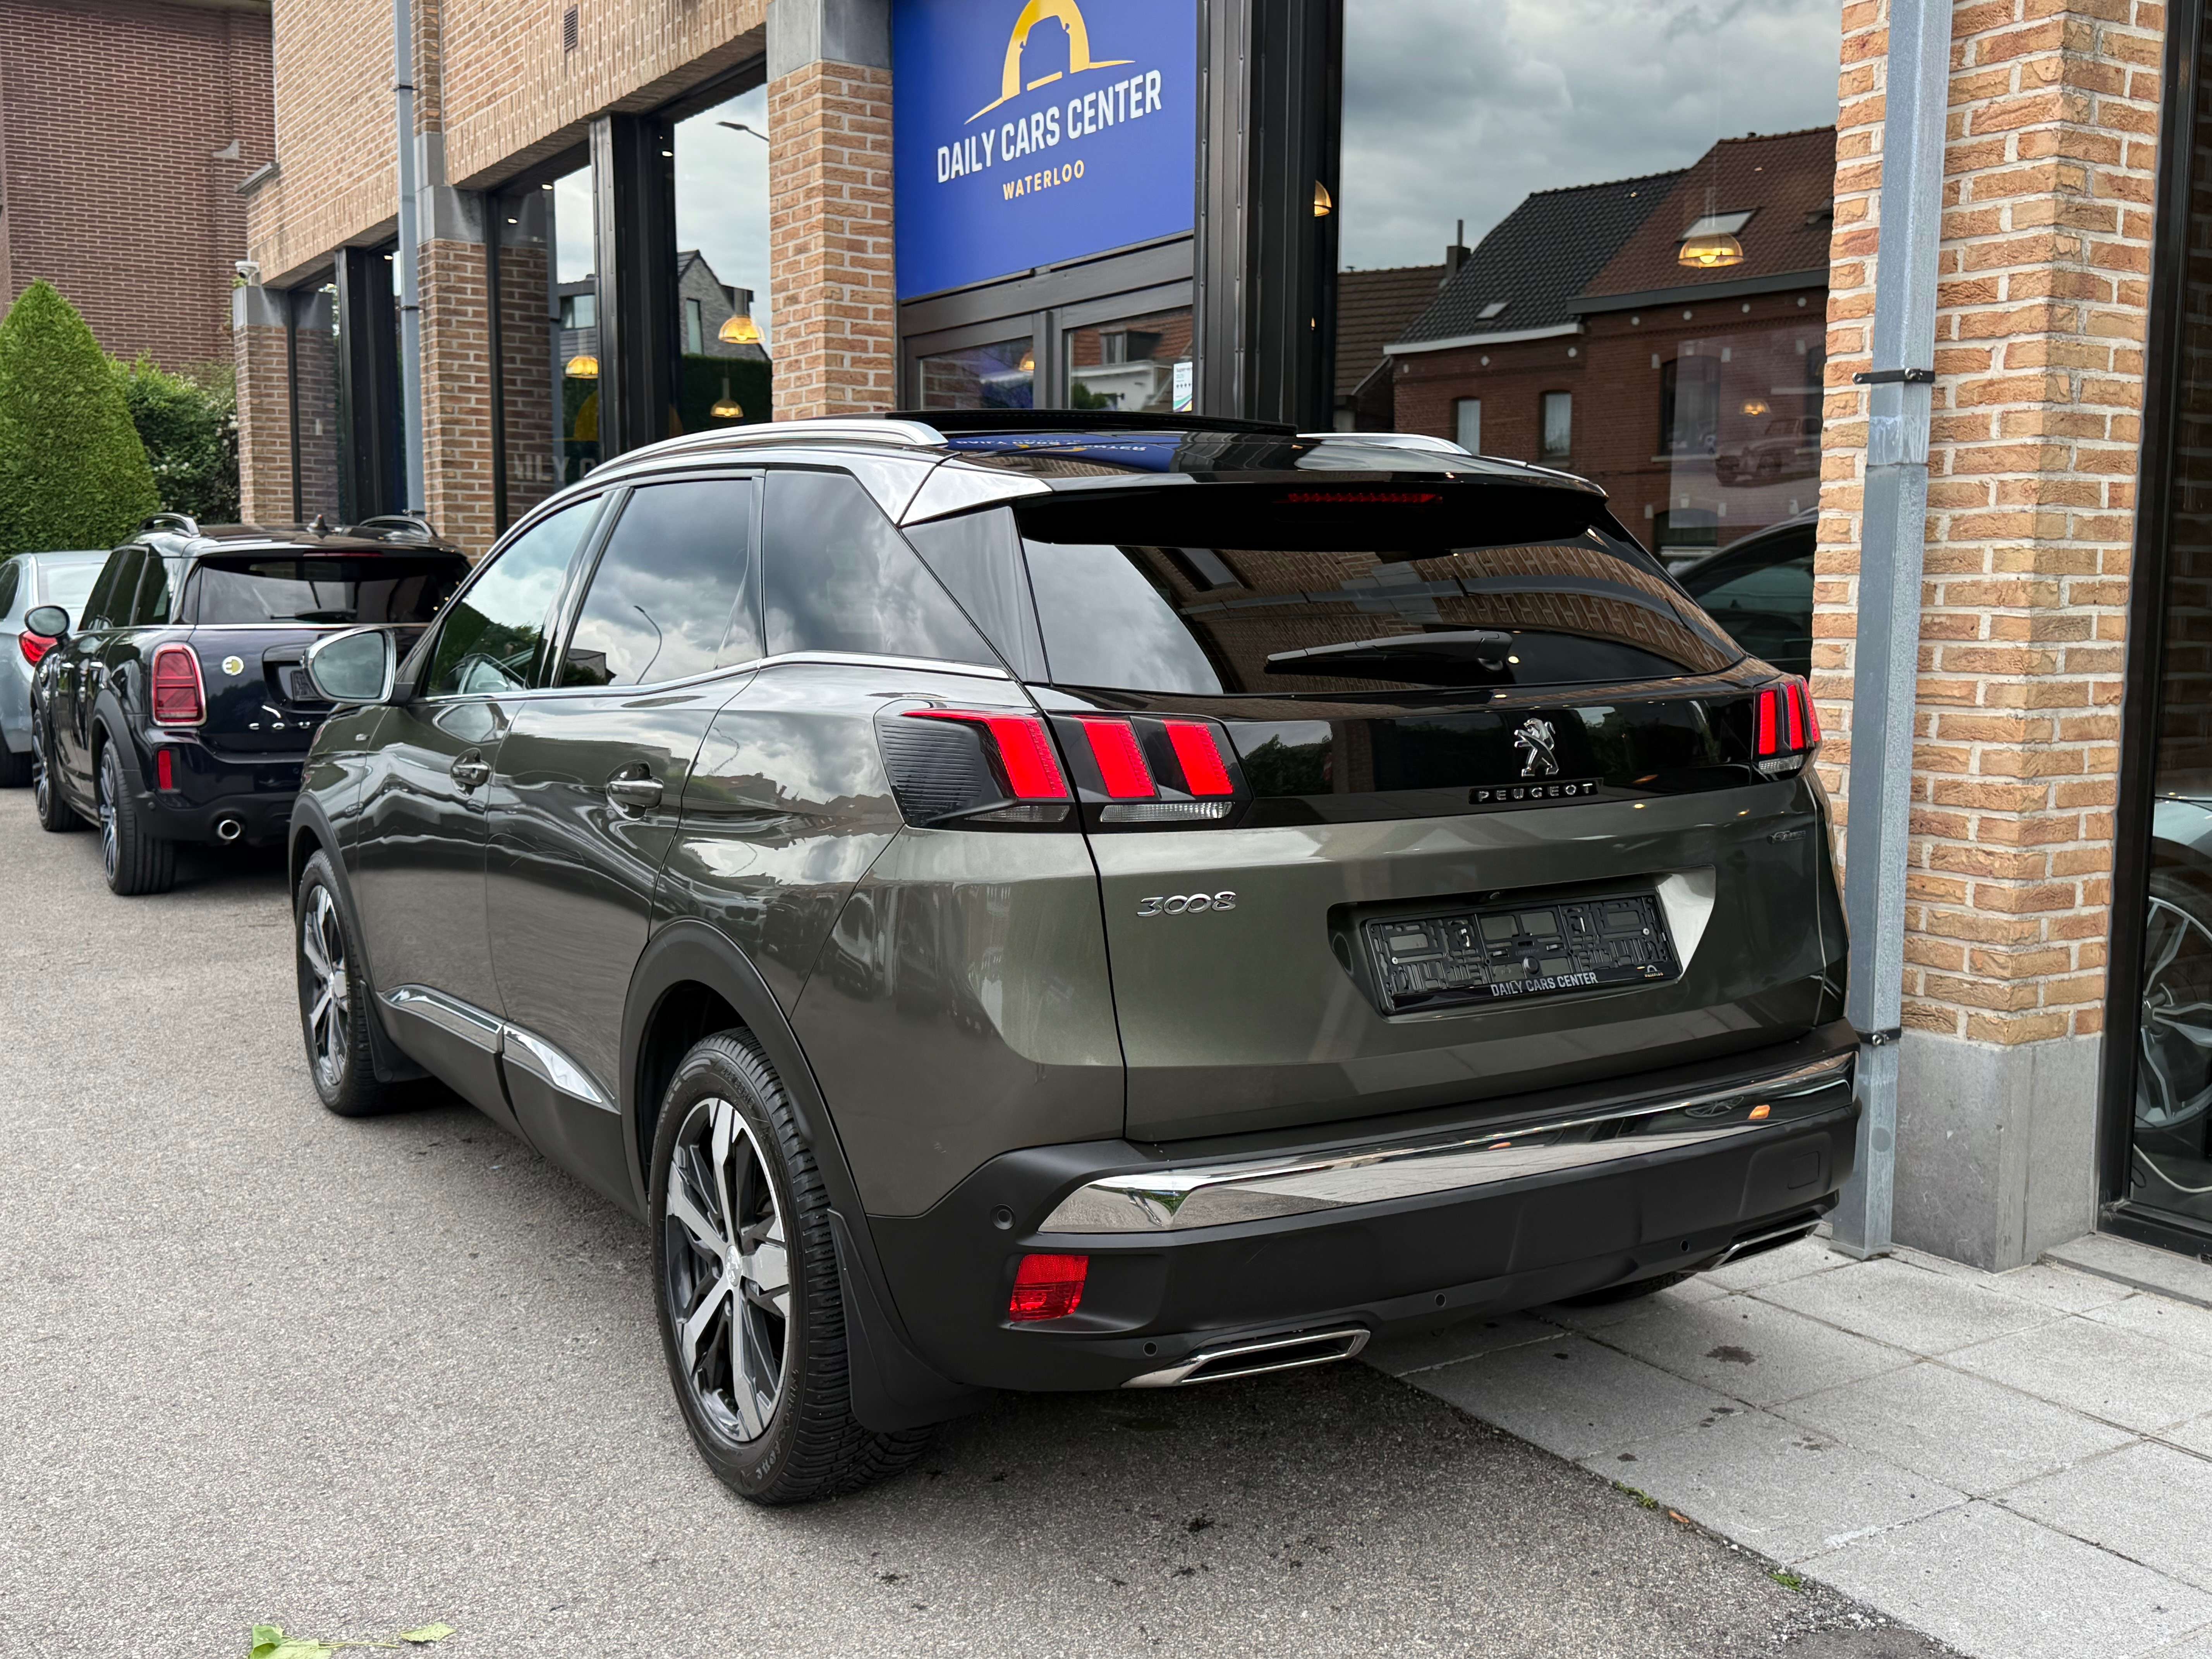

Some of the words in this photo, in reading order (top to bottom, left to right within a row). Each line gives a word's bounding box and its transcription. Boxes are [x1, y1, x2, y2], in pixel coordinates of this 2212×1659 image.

[938, 129, 996, 183] DAILY
[1001, 106, 1060, 161] CARS
[1067, 70, 1162, 139] CENTER
[1003, 160, 1085, 200] WATERLOO
[1477, 783, 1593, 802] PEUGEOT
[1137, 891, 1237, 917] 3008
[1490, 981, 1524, 996] DAILY
[1525, 977, 1556, 992] CARS
[1557, 972, 1599, 988] CENTER
